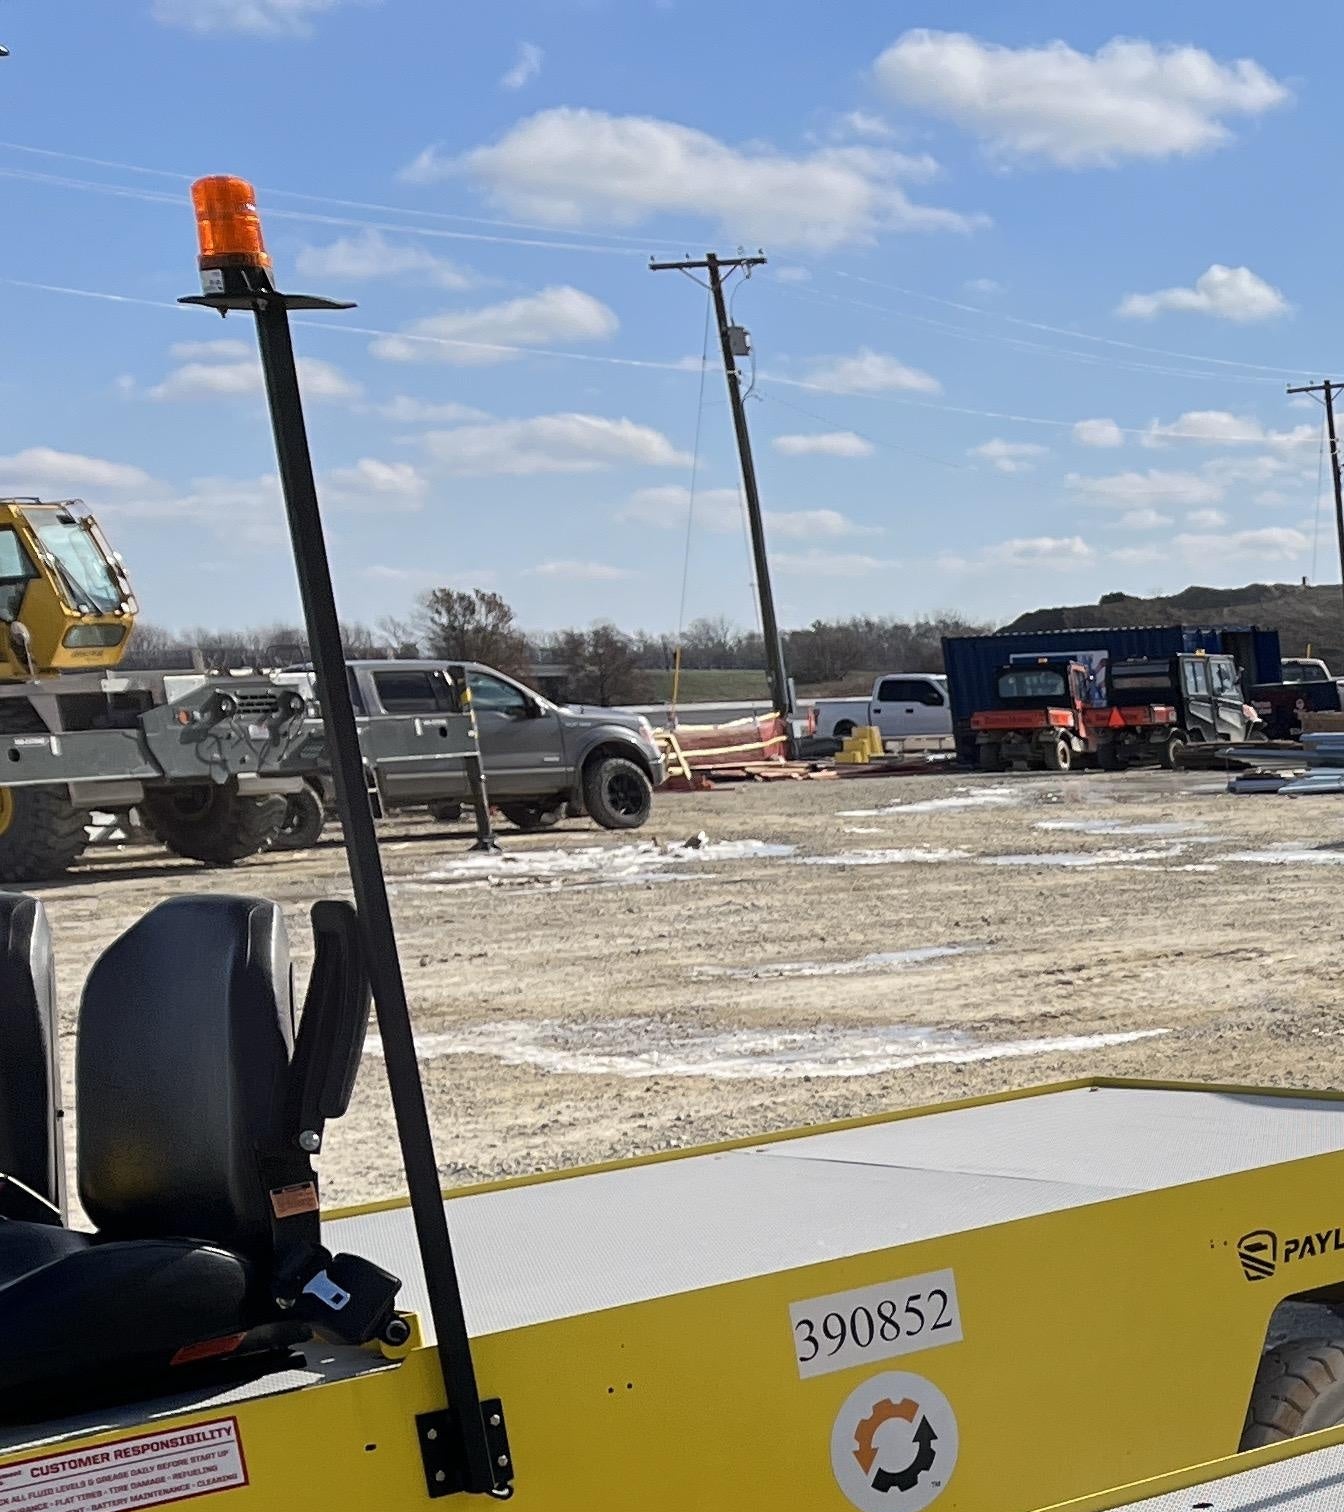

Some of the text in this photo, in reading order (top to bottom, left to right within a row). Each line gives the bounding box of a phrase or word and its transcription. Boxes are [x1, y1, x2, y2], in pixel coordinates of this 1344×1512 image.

[795, 1289, 953, 1362] 390852
[30, 1426, 232, 1478] CUSTOMER RESPONSIBILITY
[190, 1452, 215, 1463] START
[91, 1498, 128, 1511] BATTERY
